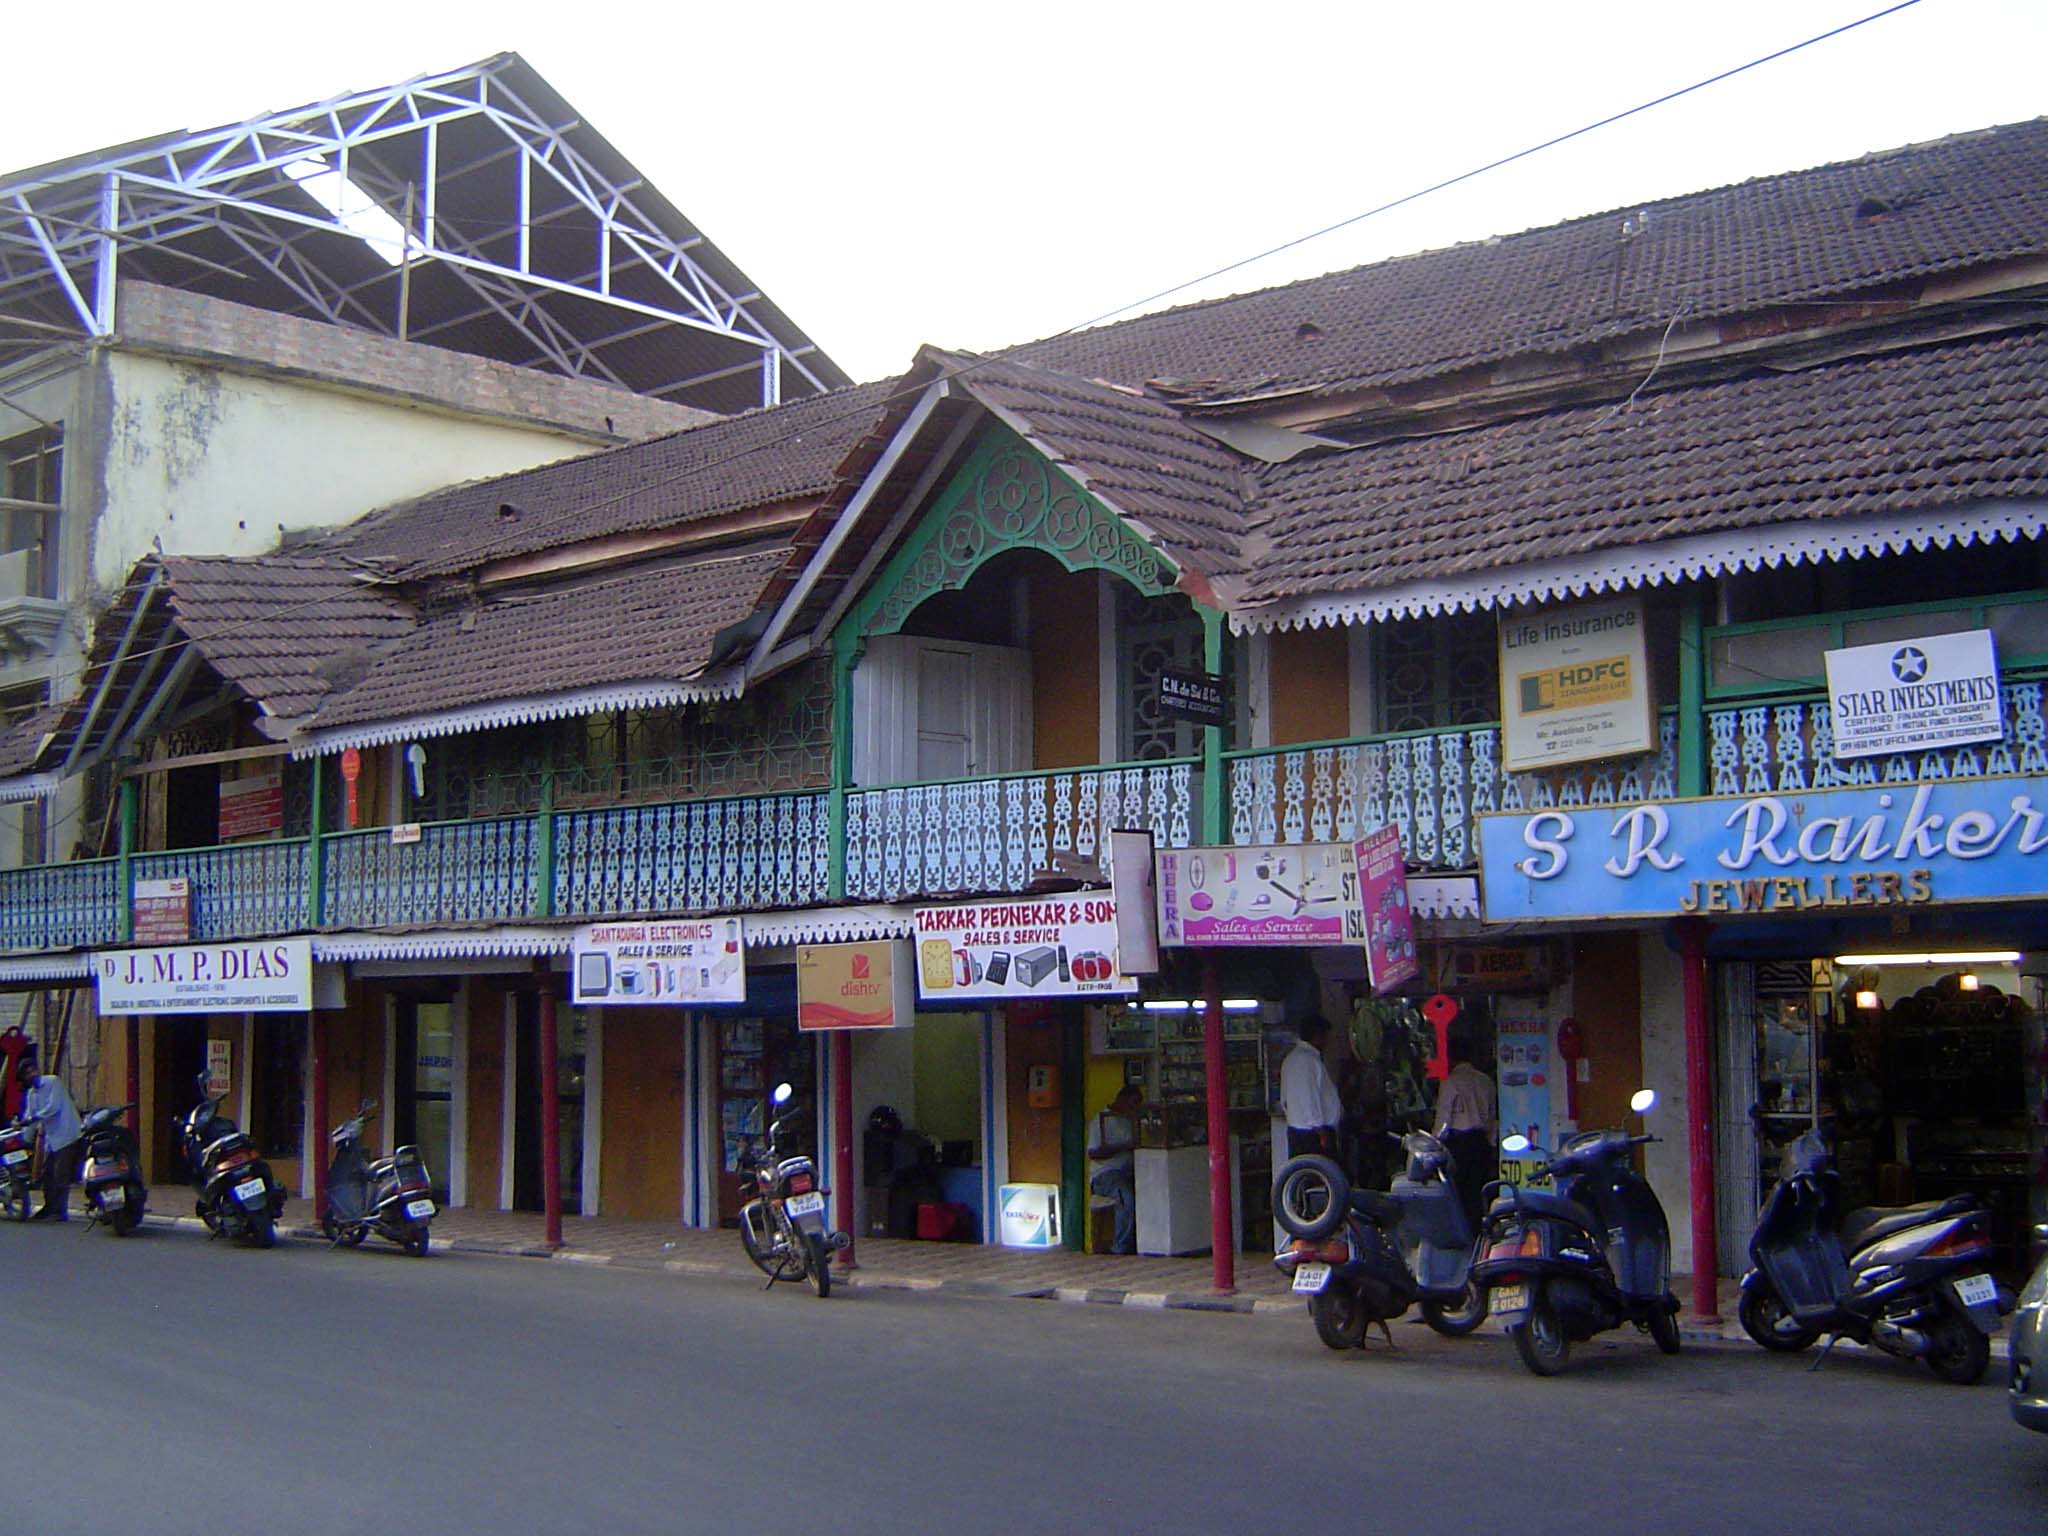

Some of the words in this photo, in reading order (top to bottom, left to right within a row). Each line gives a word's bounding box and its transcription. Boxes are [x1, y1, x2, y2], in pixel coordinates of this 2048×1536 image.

[1506, 625, 1539, 649] Life
[1559, 661, 1626, 687] HDFC
[1838, 689, 1887, 718] STAR
[1890, 675, 1996, 712] INVESTMENTS
[1844, 714, 1893, 728] CERTIFIED
[1897, 708, 1941, 721] FINANCIAL
[1943, 702, 1991, 715] CONSULTANTS
[1853, 725, 1893, 736] INSURANCE
[1902, 719, 1928, 730] MUTUAL
[1929, 717, 1950, 727] FUNDS
[1958, 713, 1984, 723] BONDS
[1869, 738, 1883, 748] POST
[1521, 811, 1576, 880] S
[1604, 804, 1686, 878] R
[1161, 854, 1179, 939] HEERA
[1679, 869, 1932, 912] JEWELLERS
[915, 908, 977, 932] TARKAR
[981, 903, 1067, 928] PEDNEKAR
[1069, 902, 1082, 923] &
[1211, 919, 1248, 934] Sales
[1262, 919, 1313, 934] Service
[591, 926, 646, 943] SHANTADURGA
[651, 924, 713, 941] ELECTRONICS
[1003, 930, 1010, 944] &
[1013, 928, 1061, 944] SERVICE
[1221, 933, 1251, 941] ELECTRICAL
[617, 945, 643, 958] SALES
[646, 945, 652, 958] &
[655, 944, 693, 957] SERVICE
[124, 955, 145, 985] J.
[152, 952, 184, 983] M.
[191, 950, 212, 981] P.
[220, 946, 290, 980] DIAS
[1500, 1160, 1521, 1185] STD
